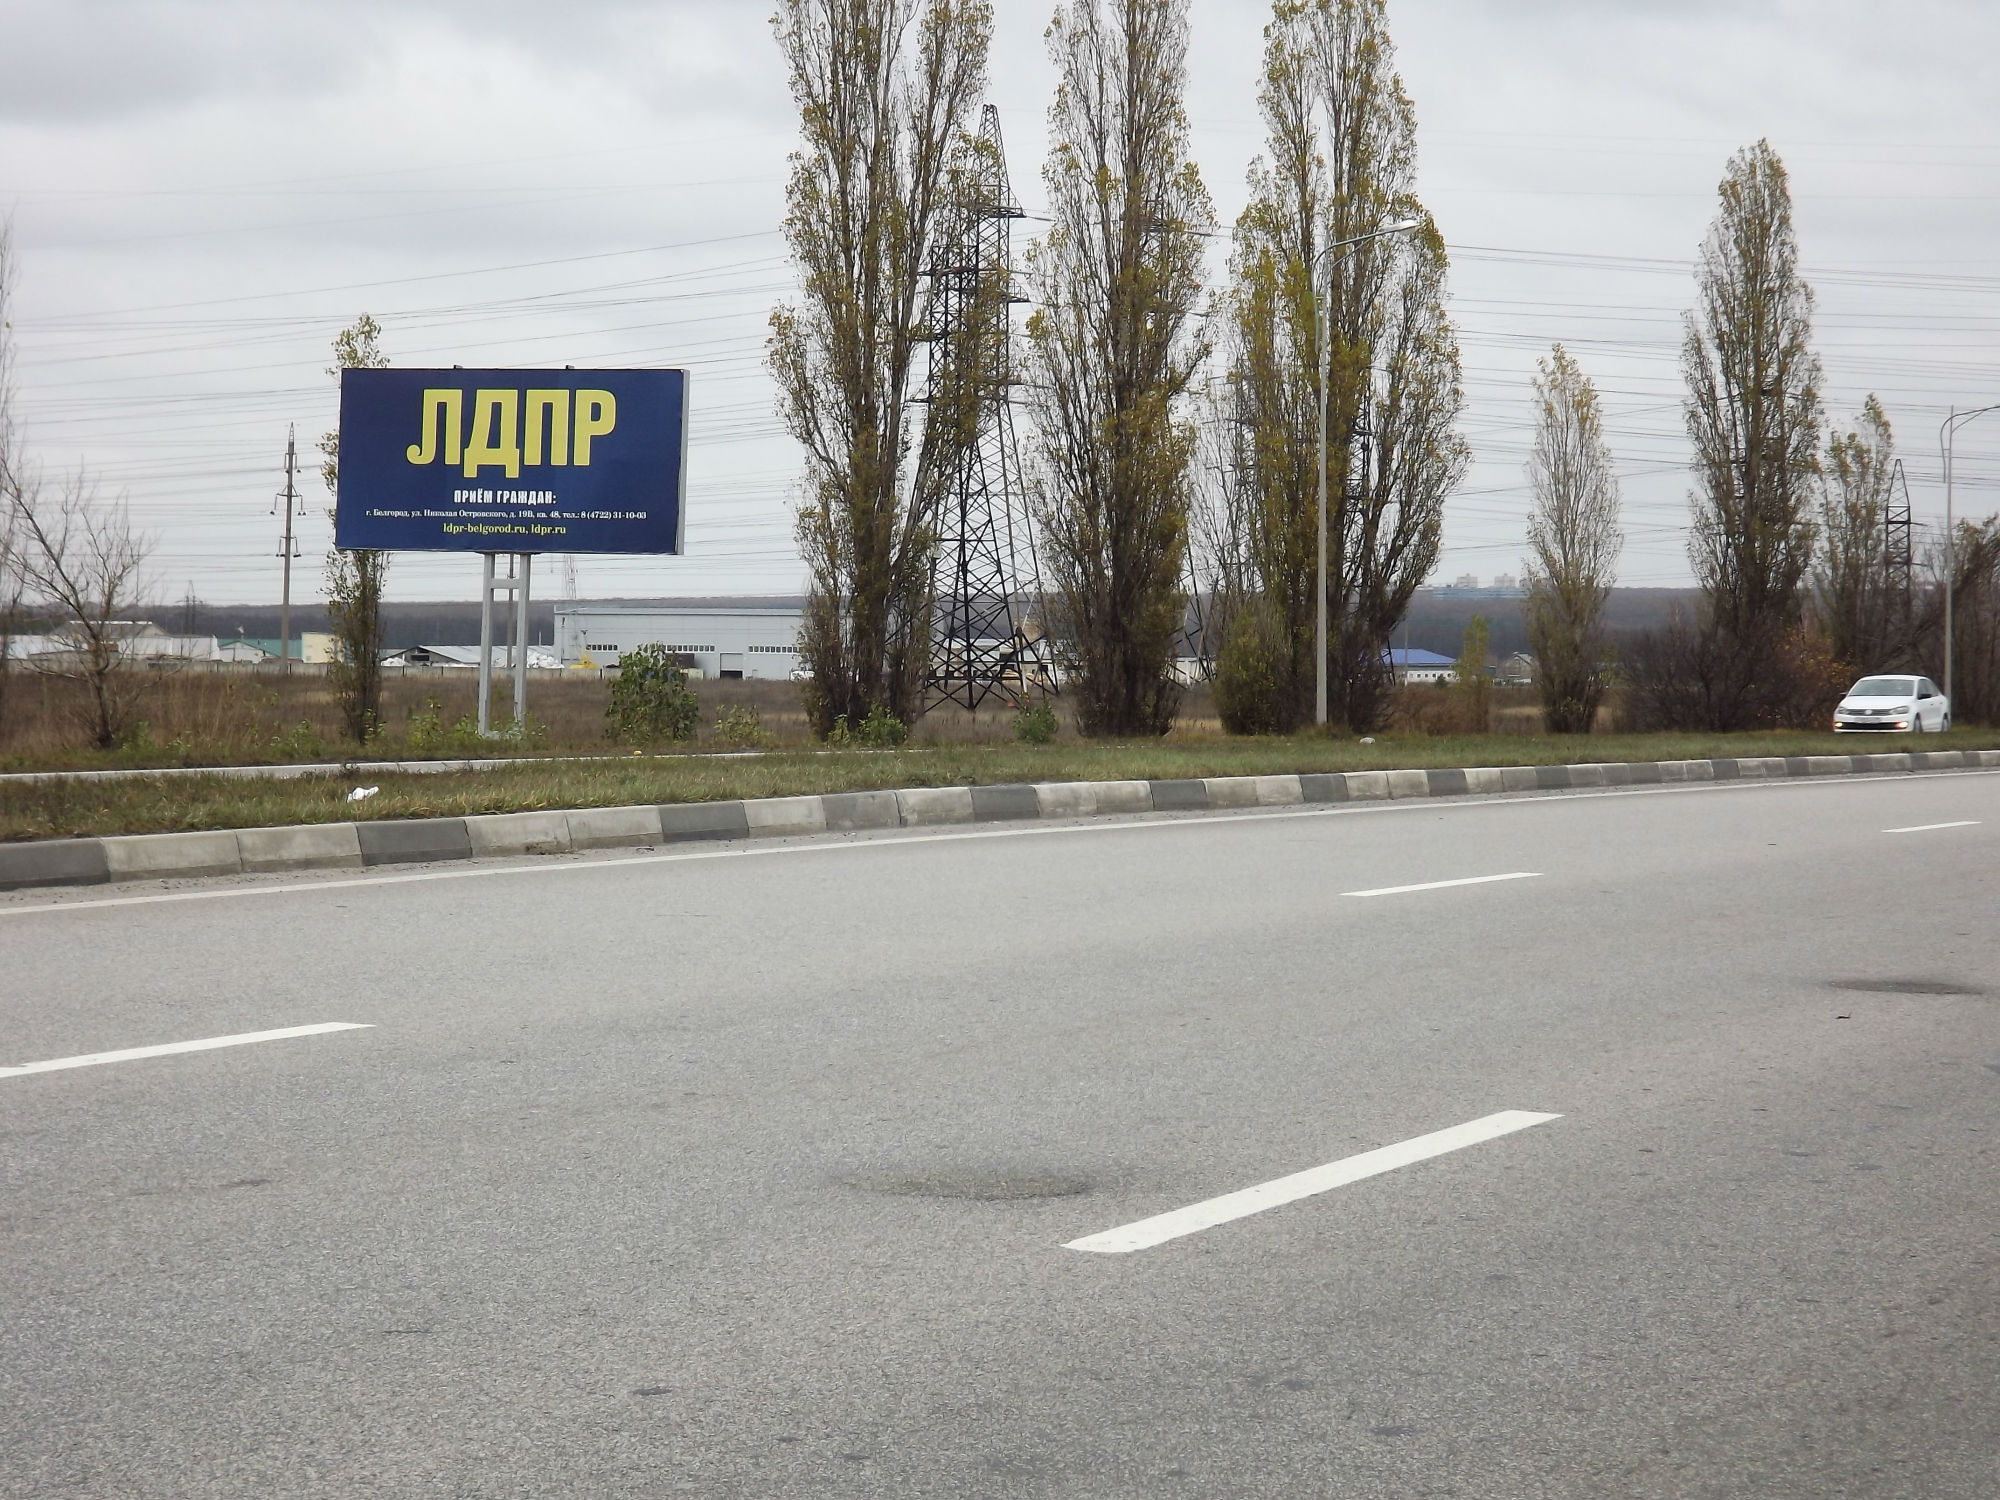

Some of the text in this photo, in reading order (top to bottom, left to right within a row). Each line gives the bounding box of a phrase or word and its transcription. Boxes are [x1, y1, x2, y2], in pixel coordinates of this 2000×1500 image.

[406, 388, 617, 478] ЛДПР
[453, 488, 557, 505] ПРИЁМ ГРАЖДАН:
[373, 509, 410, 517] Белгород,
[424, 509, 457, 517] Николая
[458, 509, 509, 519] Островского,
[550, 511, 561, 519] 48,
[587, 511, 612, 520] (4722)
[443, 523, 566, 535] ldpr-belgorod.ru, ldpr.ru
